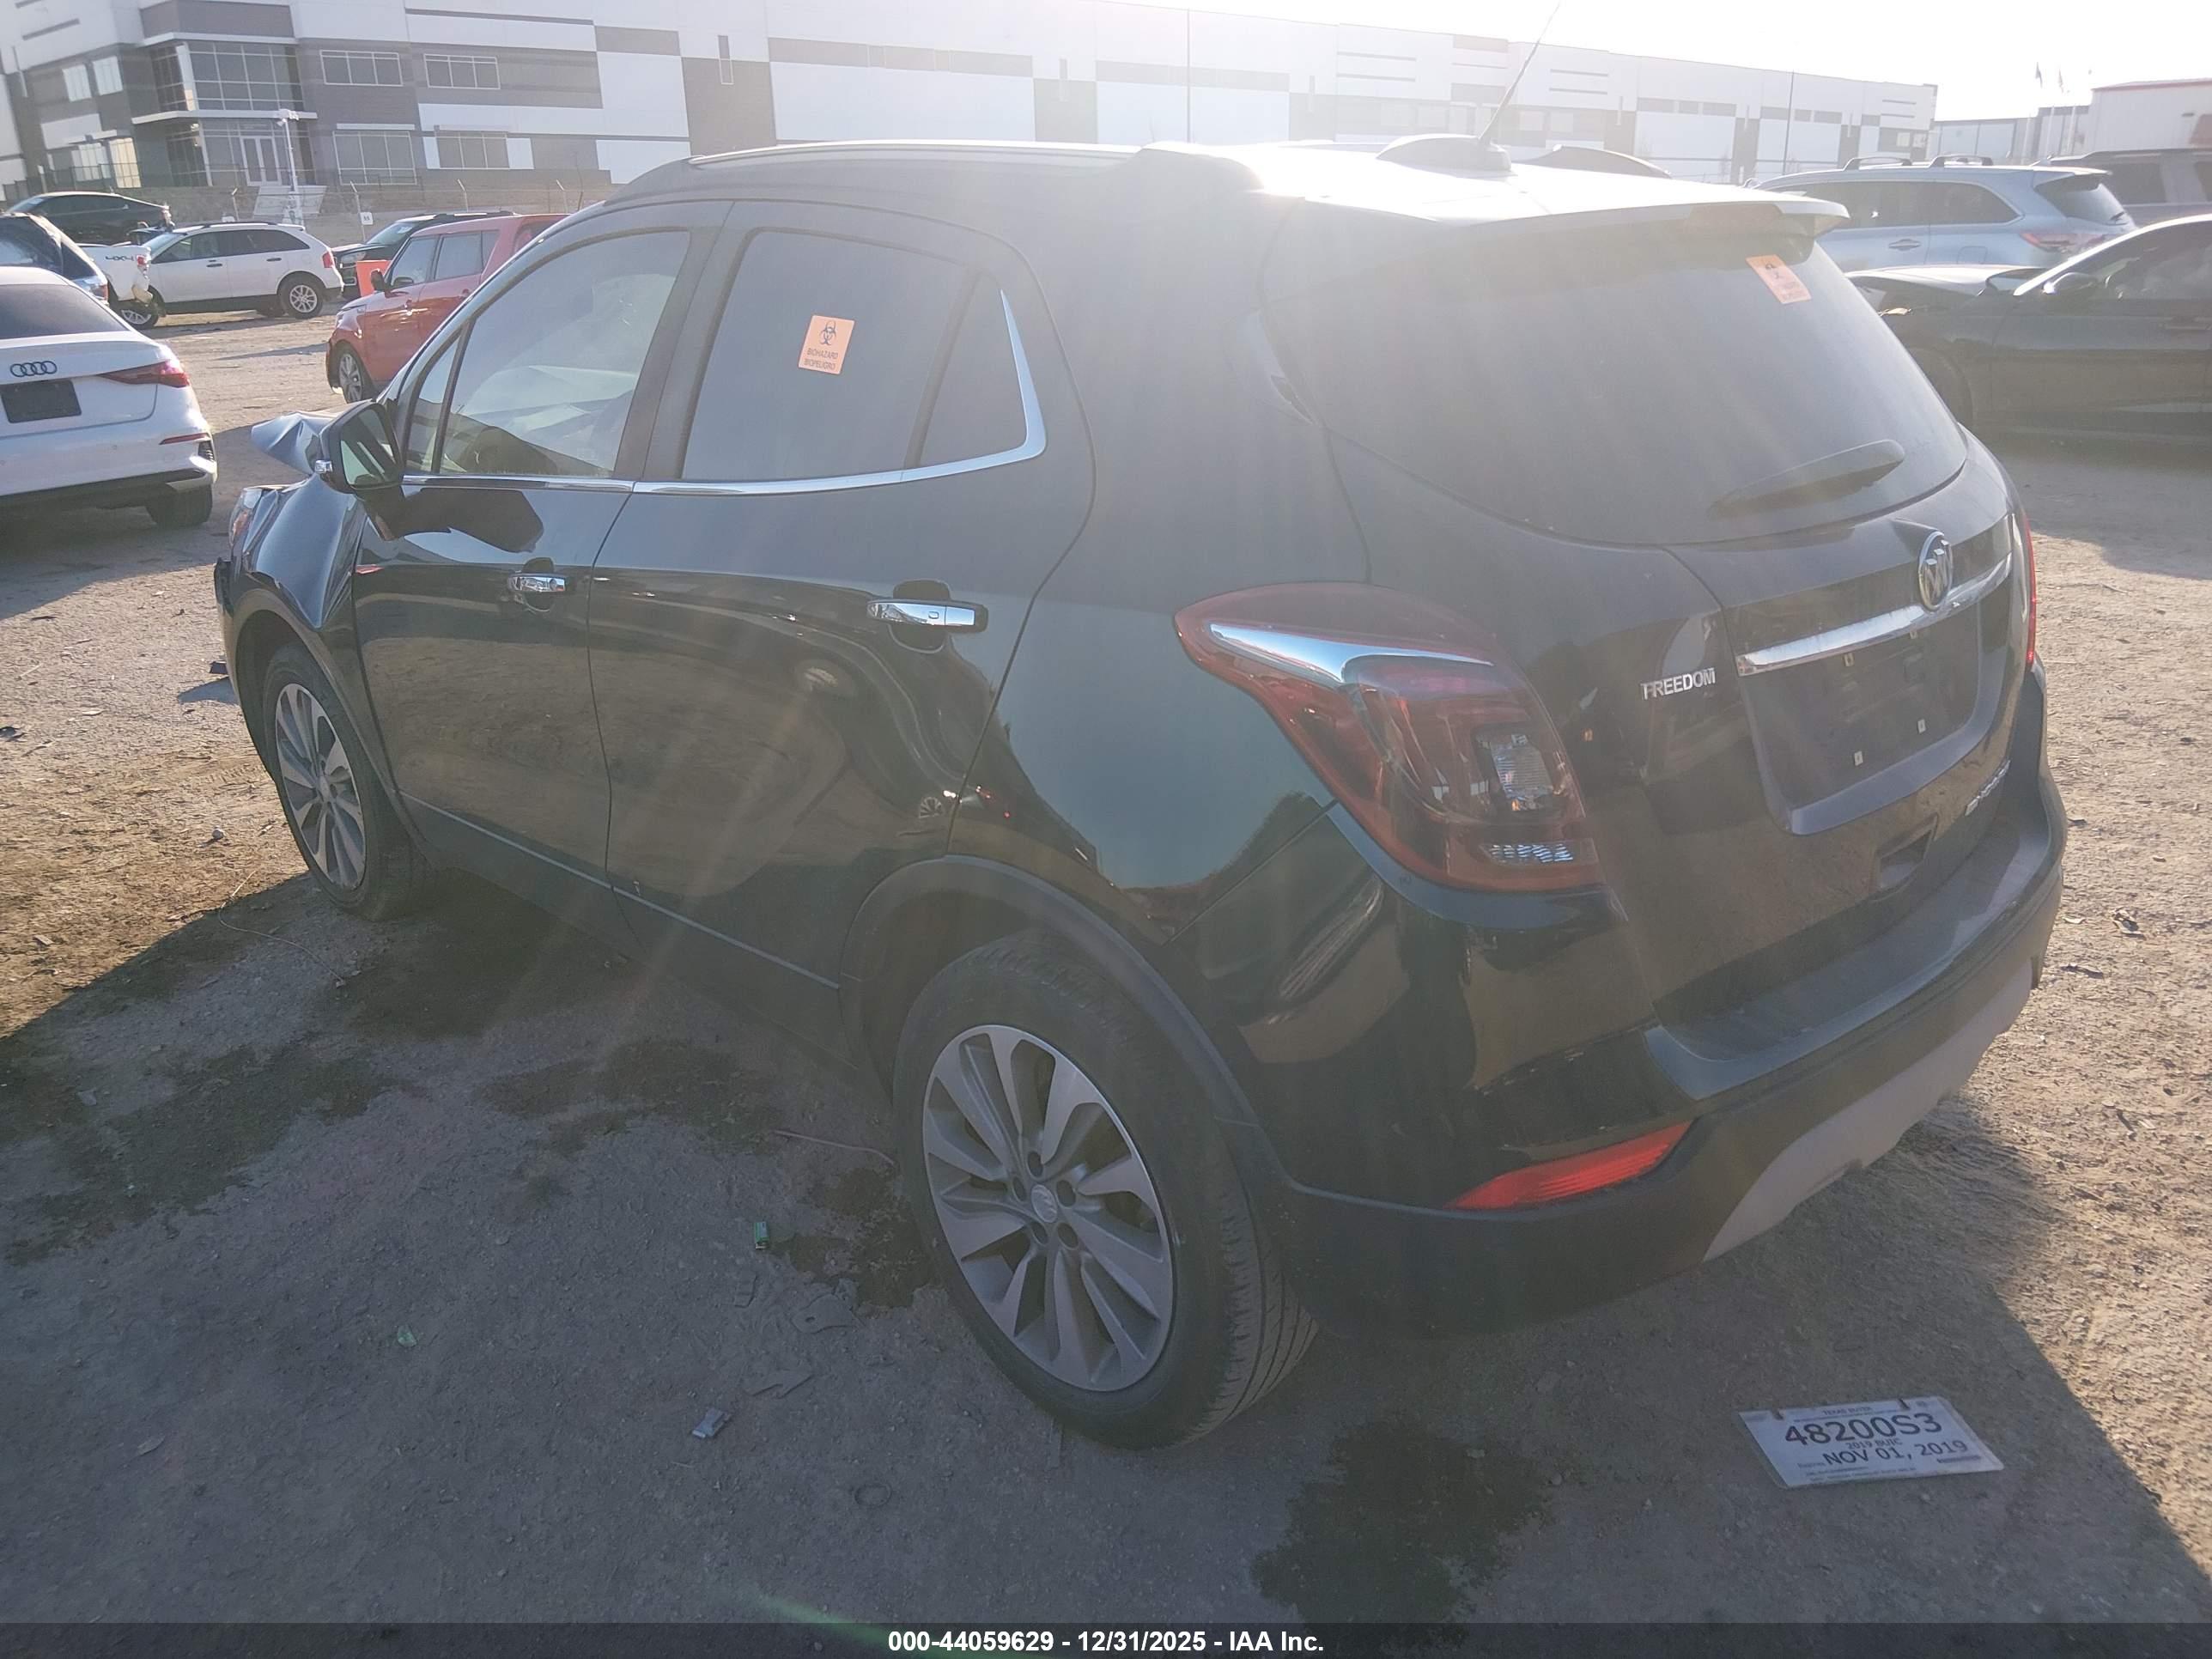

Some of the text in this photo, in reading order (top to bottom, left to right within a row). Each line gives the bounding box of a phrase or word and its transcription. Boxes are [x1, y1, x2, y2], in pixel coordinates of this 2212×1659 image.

[807, 348, 838, 359] BIOHAZARD
[803, 358, 836, 370] BIOPELIGRO
[1640, 667, 1716, 700] FREEDOM
[1785, 1413, 1942, 1445] 48200S3
[1822, 1449, 1869, 1465] NOV
[1875, 1447, 1912, 1460] 01,
[1914, 1440, 1968, 1456] 2019
[1846, 1440, 1873, 1449] 2019
